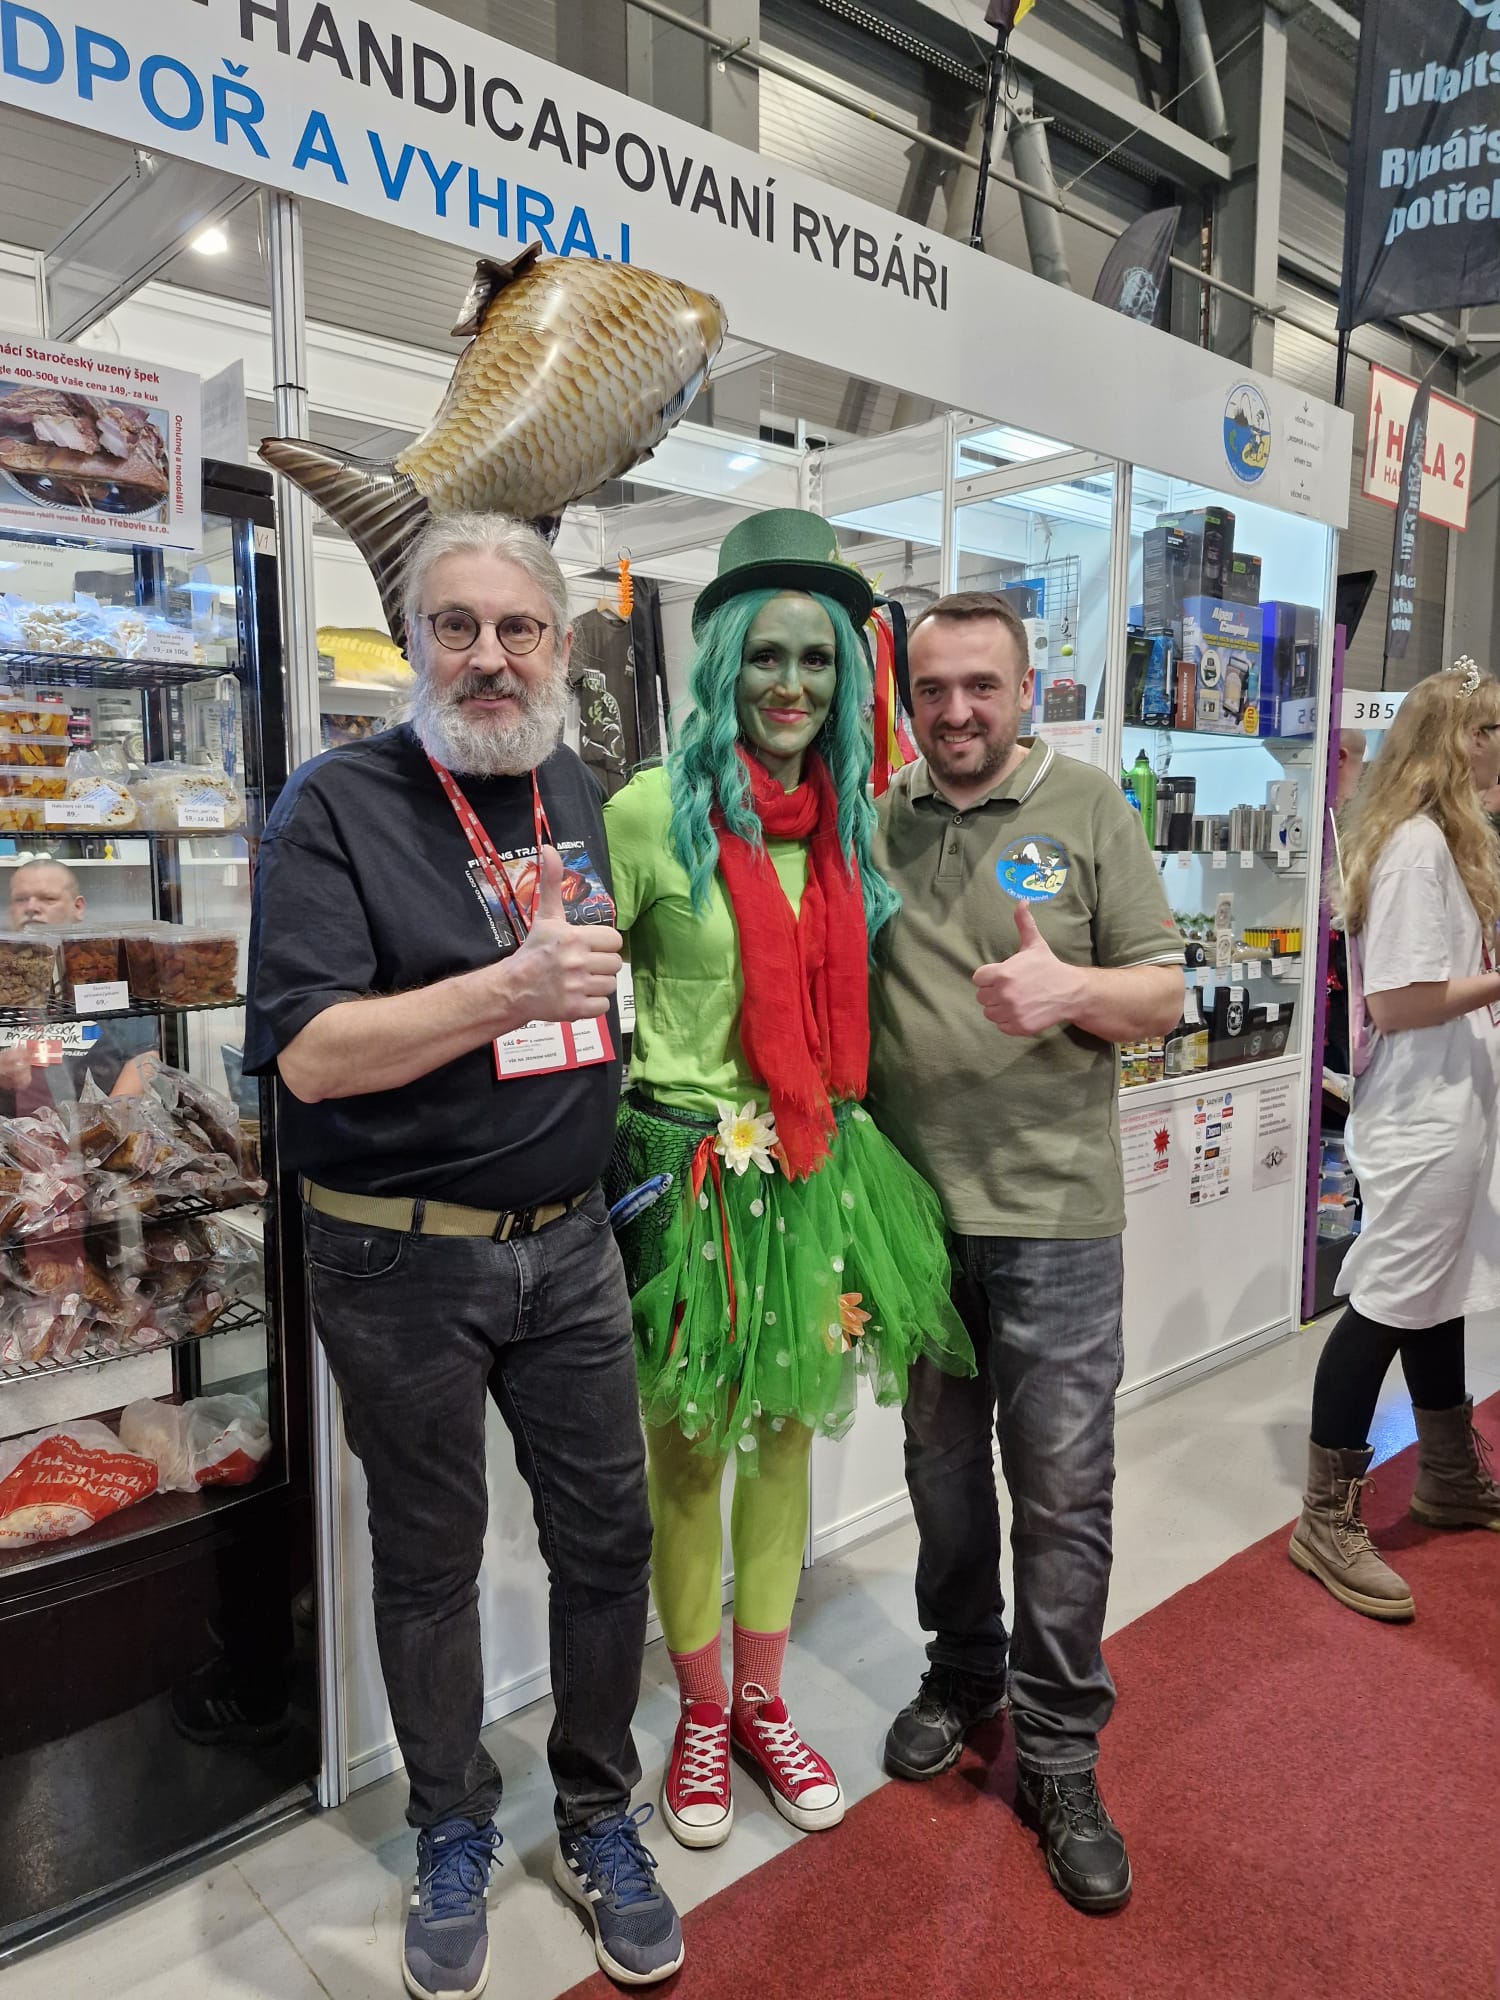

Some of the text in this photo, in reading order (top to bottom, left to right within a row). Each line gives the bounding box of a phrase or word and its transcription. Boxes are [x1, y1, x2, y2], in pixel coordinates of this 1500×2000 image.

[238, 0, 949, 311] HANDICAPOVANÍ RYBÁŘI
[292, 110, 349, 186] A
[26, 347, 94, 372] Staročeský
[97, 362, 132, 380] uzený
[134, 367, 160, 384] špek
[14, 367, 59, 385] 400-500g
[61, 375, 84, 388] Vaše
[86, 382, 107, 392] cena
[133, 391, 142, 399] za
[144, 389, 159, 402] kus
[1386, 419, 1466, 489] HLA 2
[81, 514, 106, 526] Maso
[557, 840, 586, 850] AGENCY
